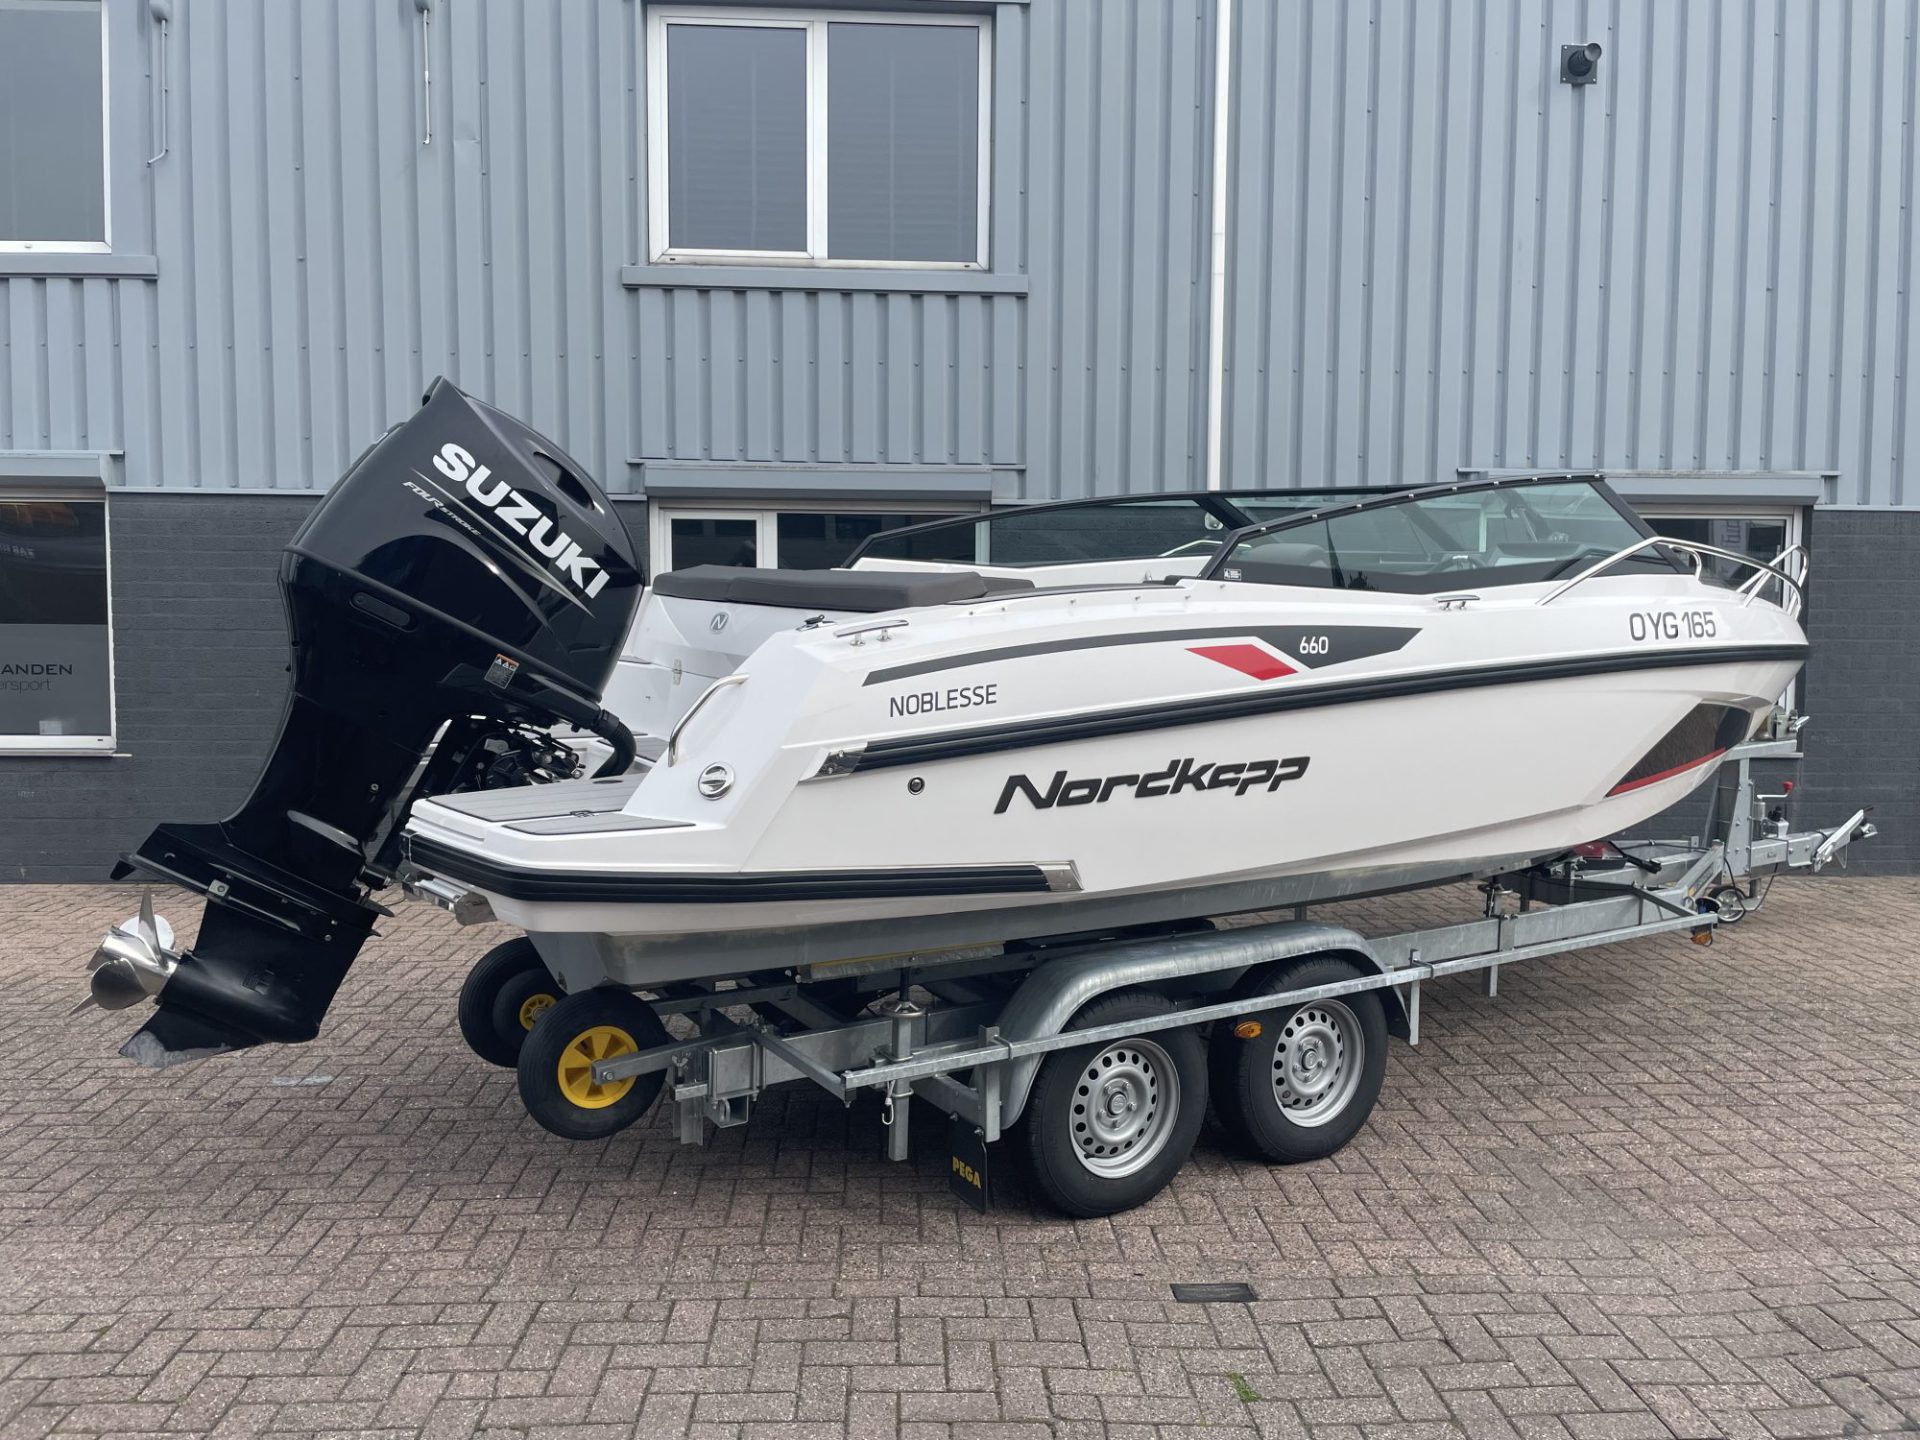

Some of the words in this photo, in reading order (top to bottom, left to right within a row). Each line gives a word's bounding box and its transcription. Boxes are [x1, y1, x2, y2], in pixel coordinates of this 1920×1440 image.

[401, 481, 445, 509] FOUR
[432, 442, 611, 600] SUZUKI
[1629, 611, 1679, 641] OYG
[1681, 611, 1717, 639] 165
[1299, 635, 1329, 655] 660
[1, 663, 73, 675] ANDEN
[889, 683, 998, 718] NOBLESSE
[993, 755, 1311, 815] Nordkapp
[952, 1155, 982, 1190] PEGA
